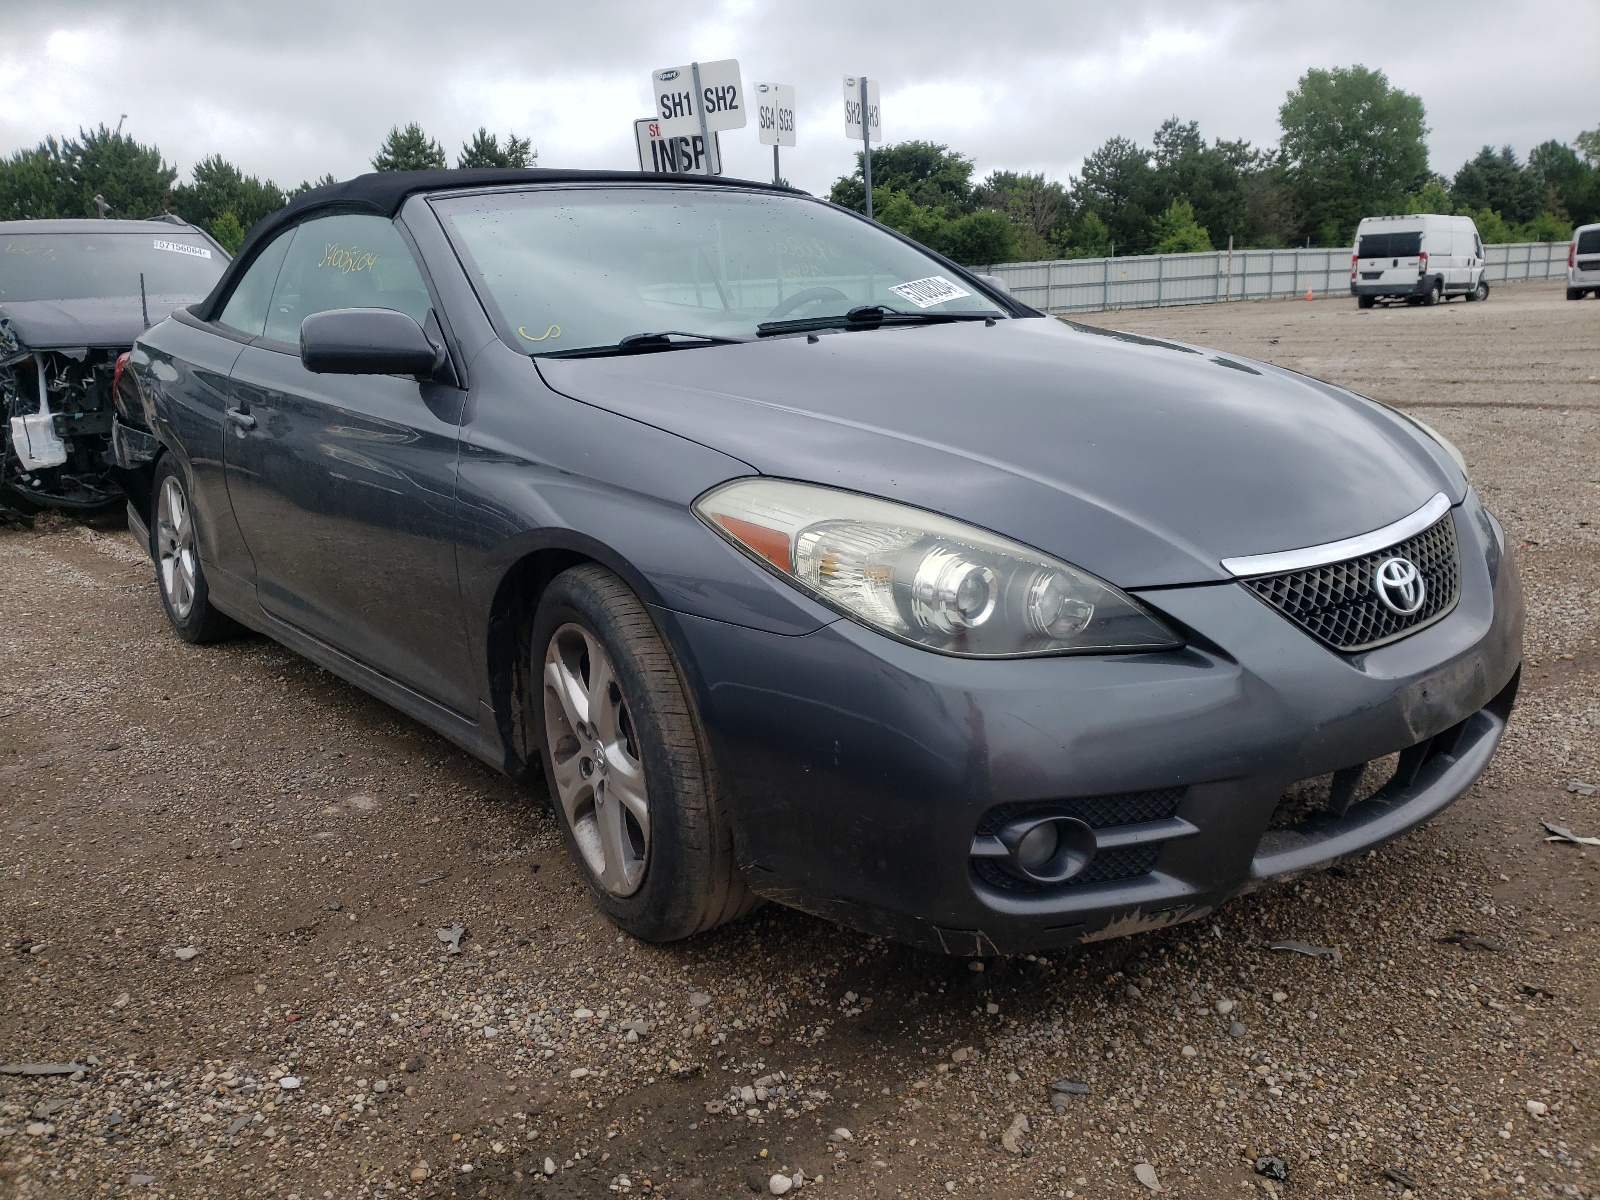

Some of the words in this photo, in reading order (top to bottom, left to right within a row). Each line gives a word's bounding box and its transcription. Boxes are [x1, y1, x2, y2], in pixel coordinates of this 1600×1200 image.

[660, 91, 692, 119] SH1
[703, 85, 738, 113] SH2
[760, 106, 775, 129] SG4
[779, 108, 793, 131] SG3
[846, 100, 861, 124] SH2
[866, 104, 879, 127] H3
